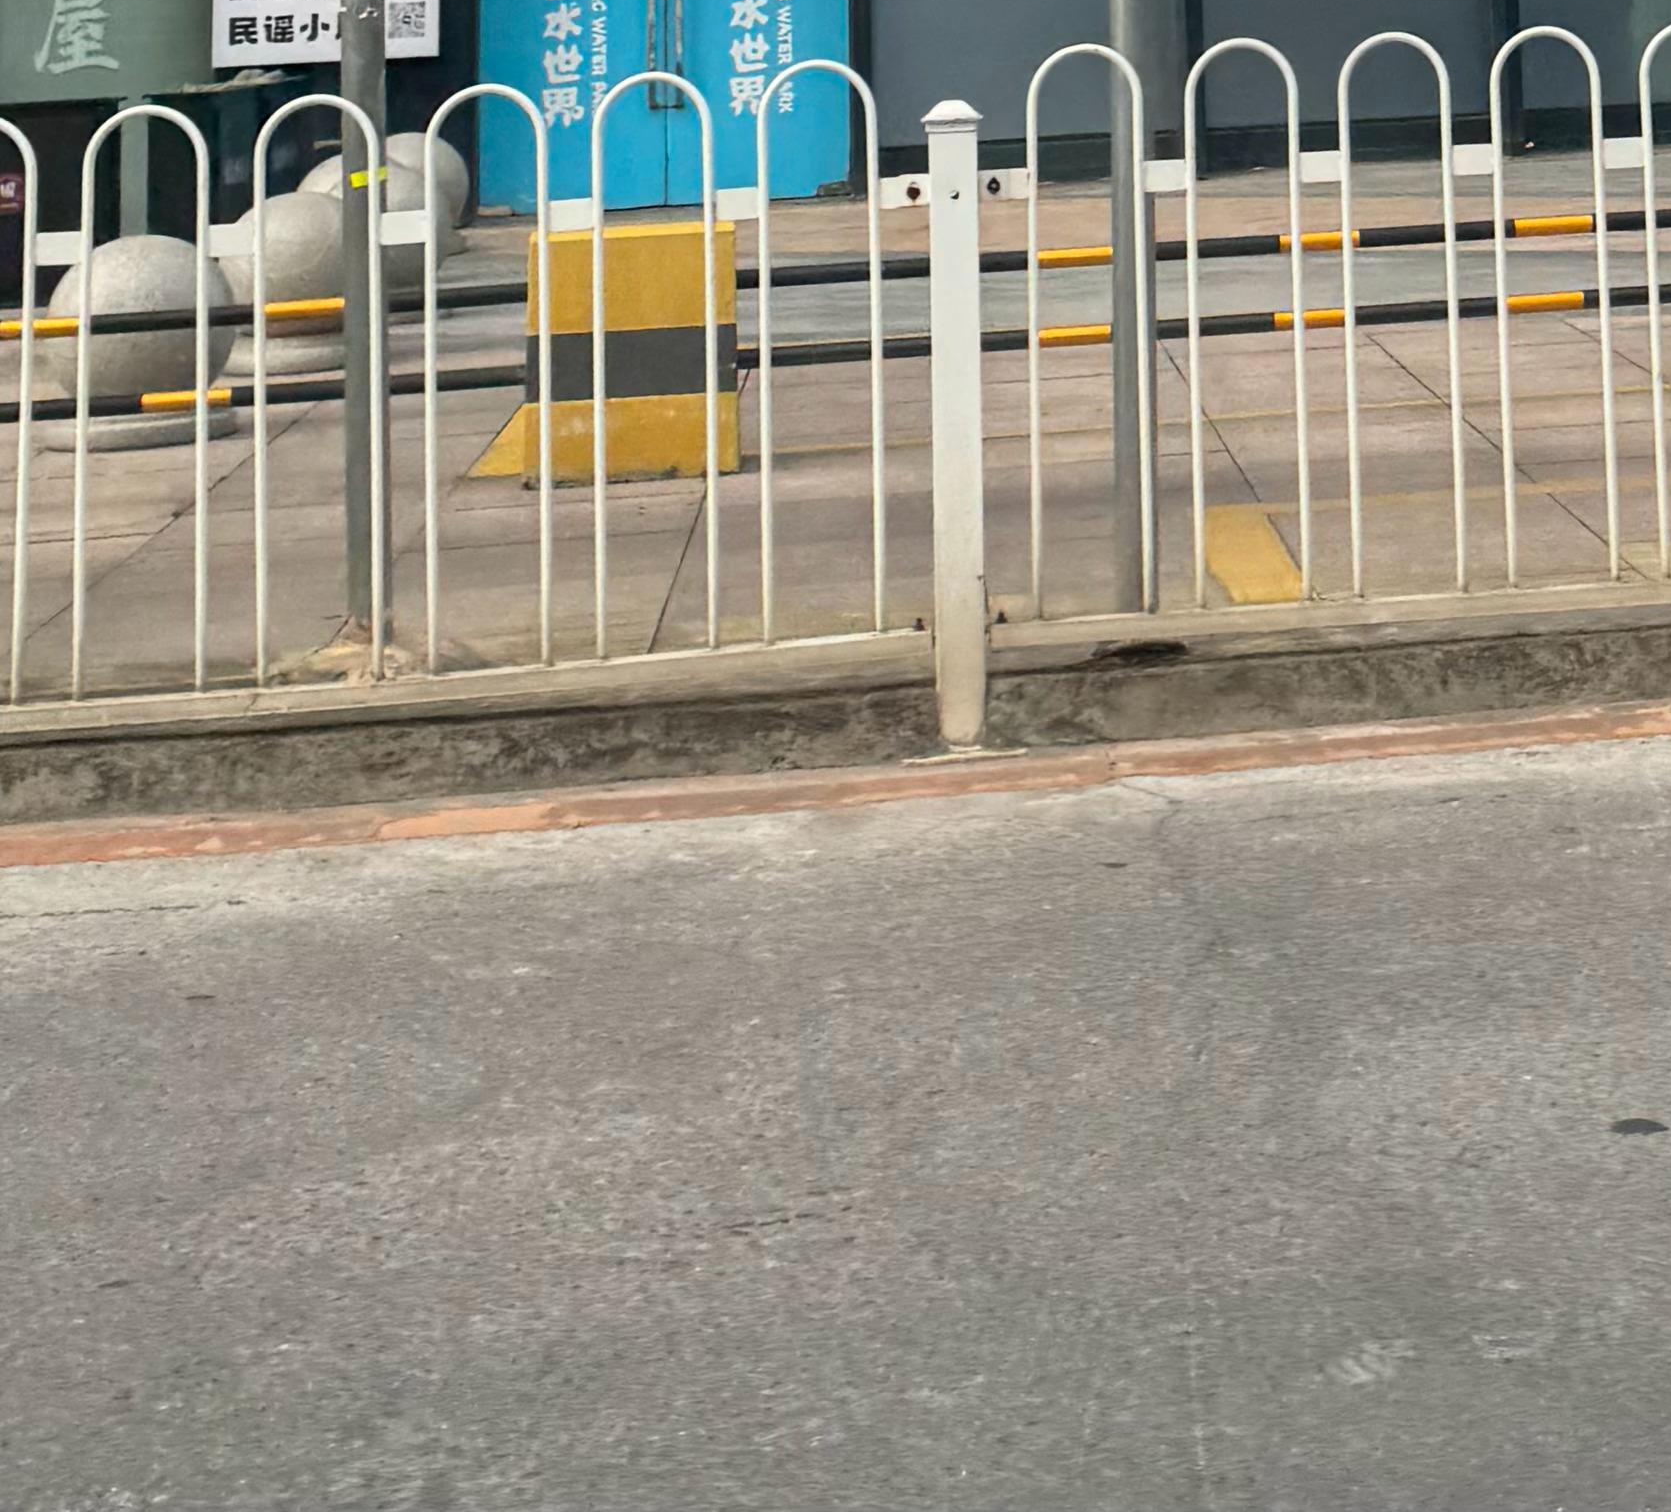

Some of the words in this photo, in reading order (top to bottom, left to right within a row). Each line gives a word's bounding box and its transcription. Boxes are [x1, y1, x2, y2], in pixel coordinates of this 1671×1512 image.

[229, 13, 343, 46] 民谣小
[591, 16, 608, 75] WATER
[777, 4, 793, 65] WATER
